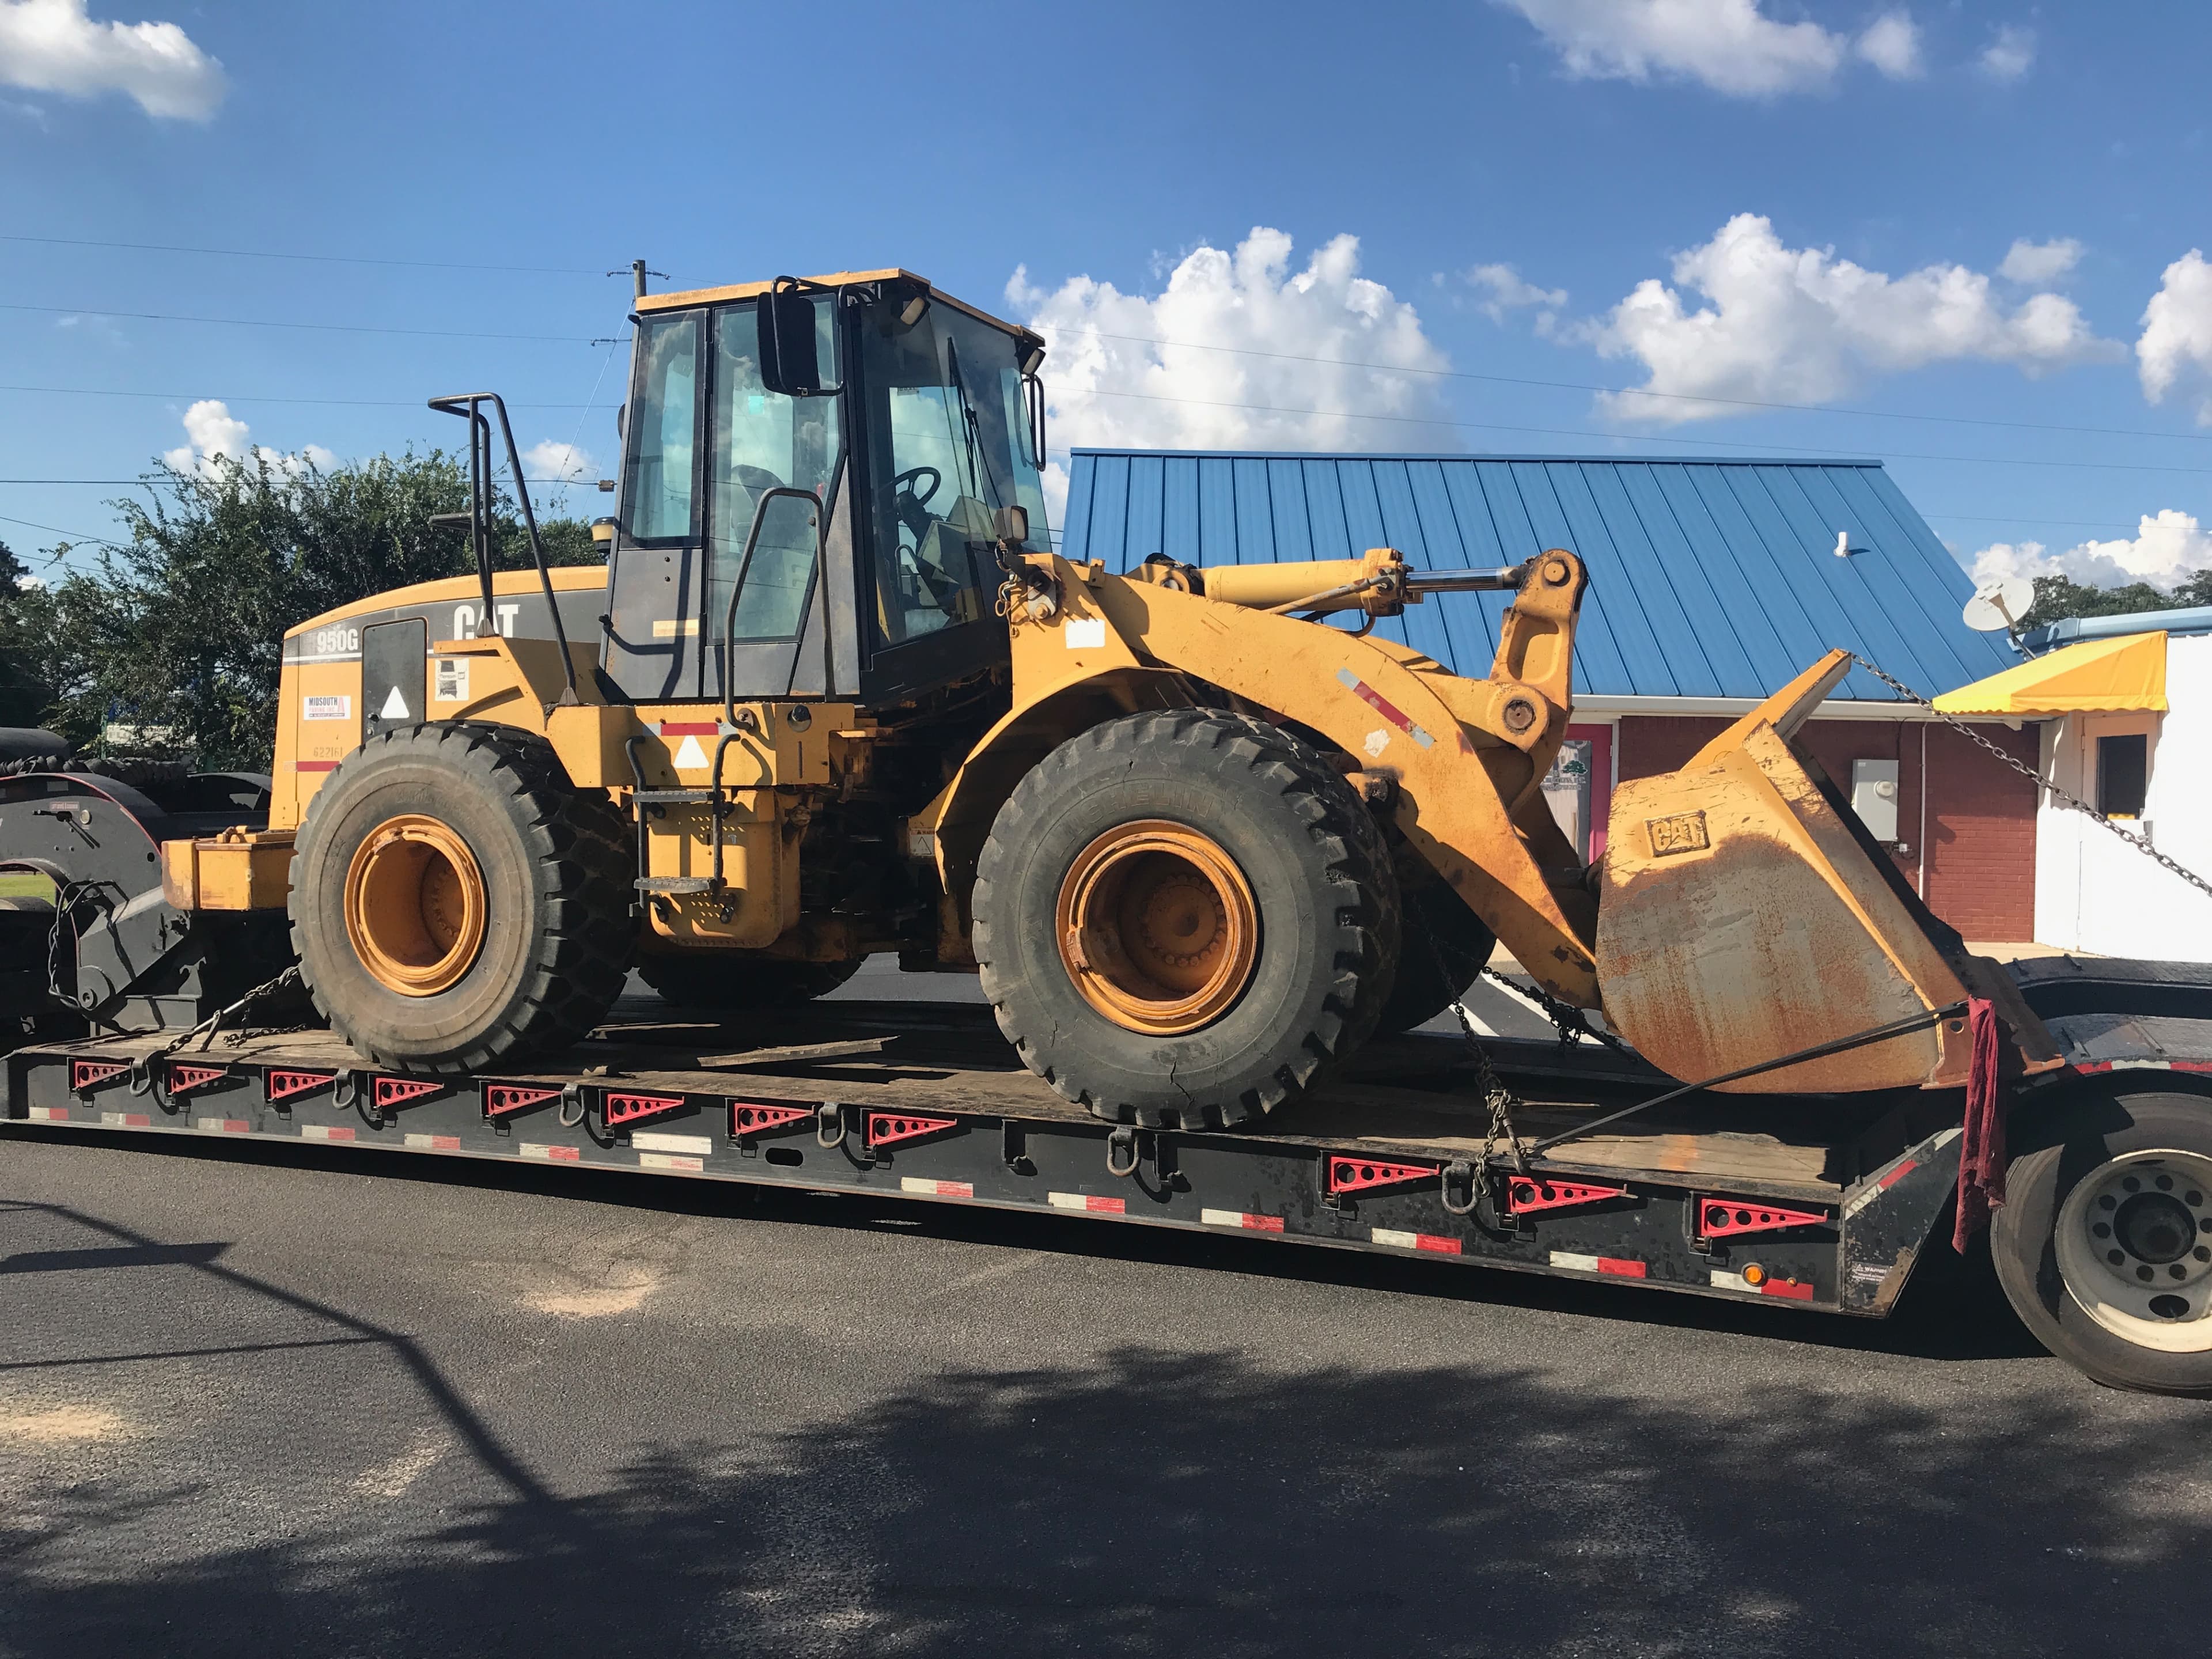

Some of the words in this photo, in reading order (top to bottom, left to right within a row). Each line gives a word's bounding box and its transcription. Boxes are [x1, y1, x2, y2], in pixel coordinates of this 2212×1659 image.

[317, 628, 358, 653] 950G
[308, 696, 338, 706] MIDSOUTH
[1652, 816, 1702, 852] CAT
